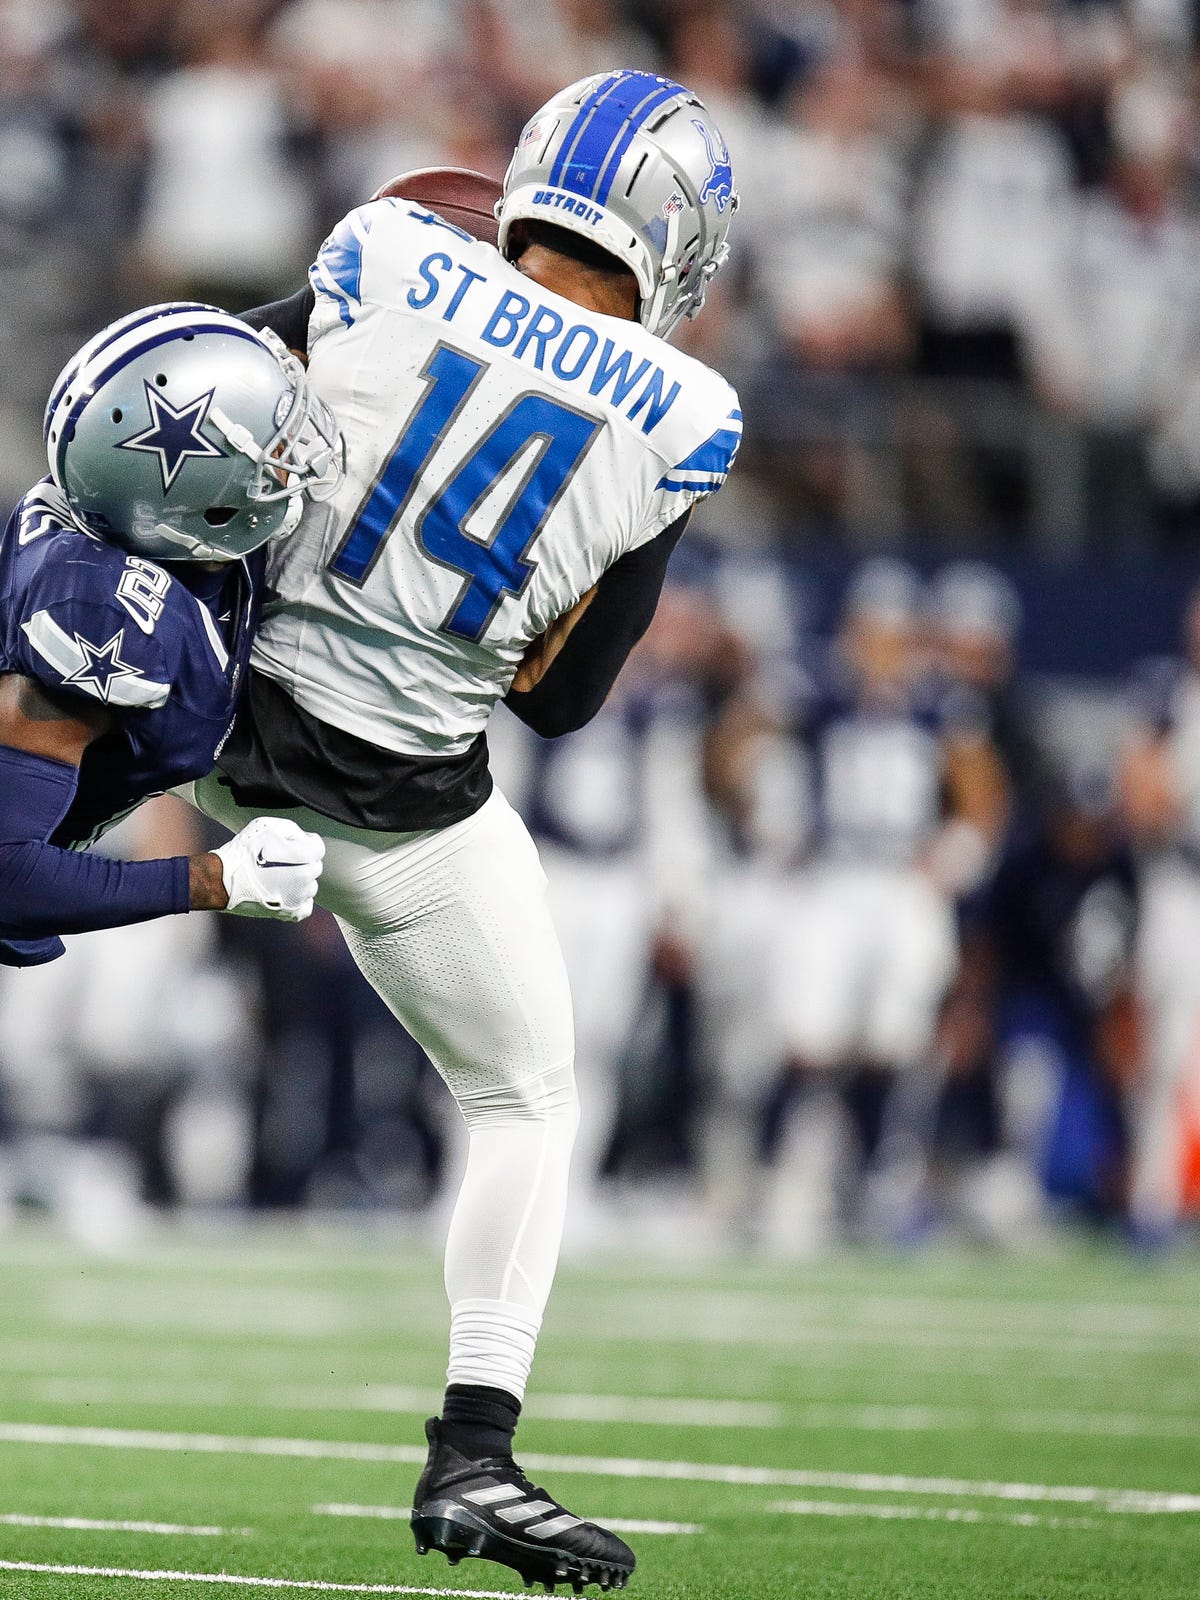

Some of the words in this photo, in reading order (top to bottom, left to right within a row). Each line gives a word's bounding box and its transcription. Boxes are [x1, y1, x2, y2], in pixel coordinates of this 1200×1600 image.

[533, 191, 603, 225] DETROIT
[406, 252, 488, 322] ST
[480, 290, 682, 436] BROWN
[328, 340, 605, 643] 14
